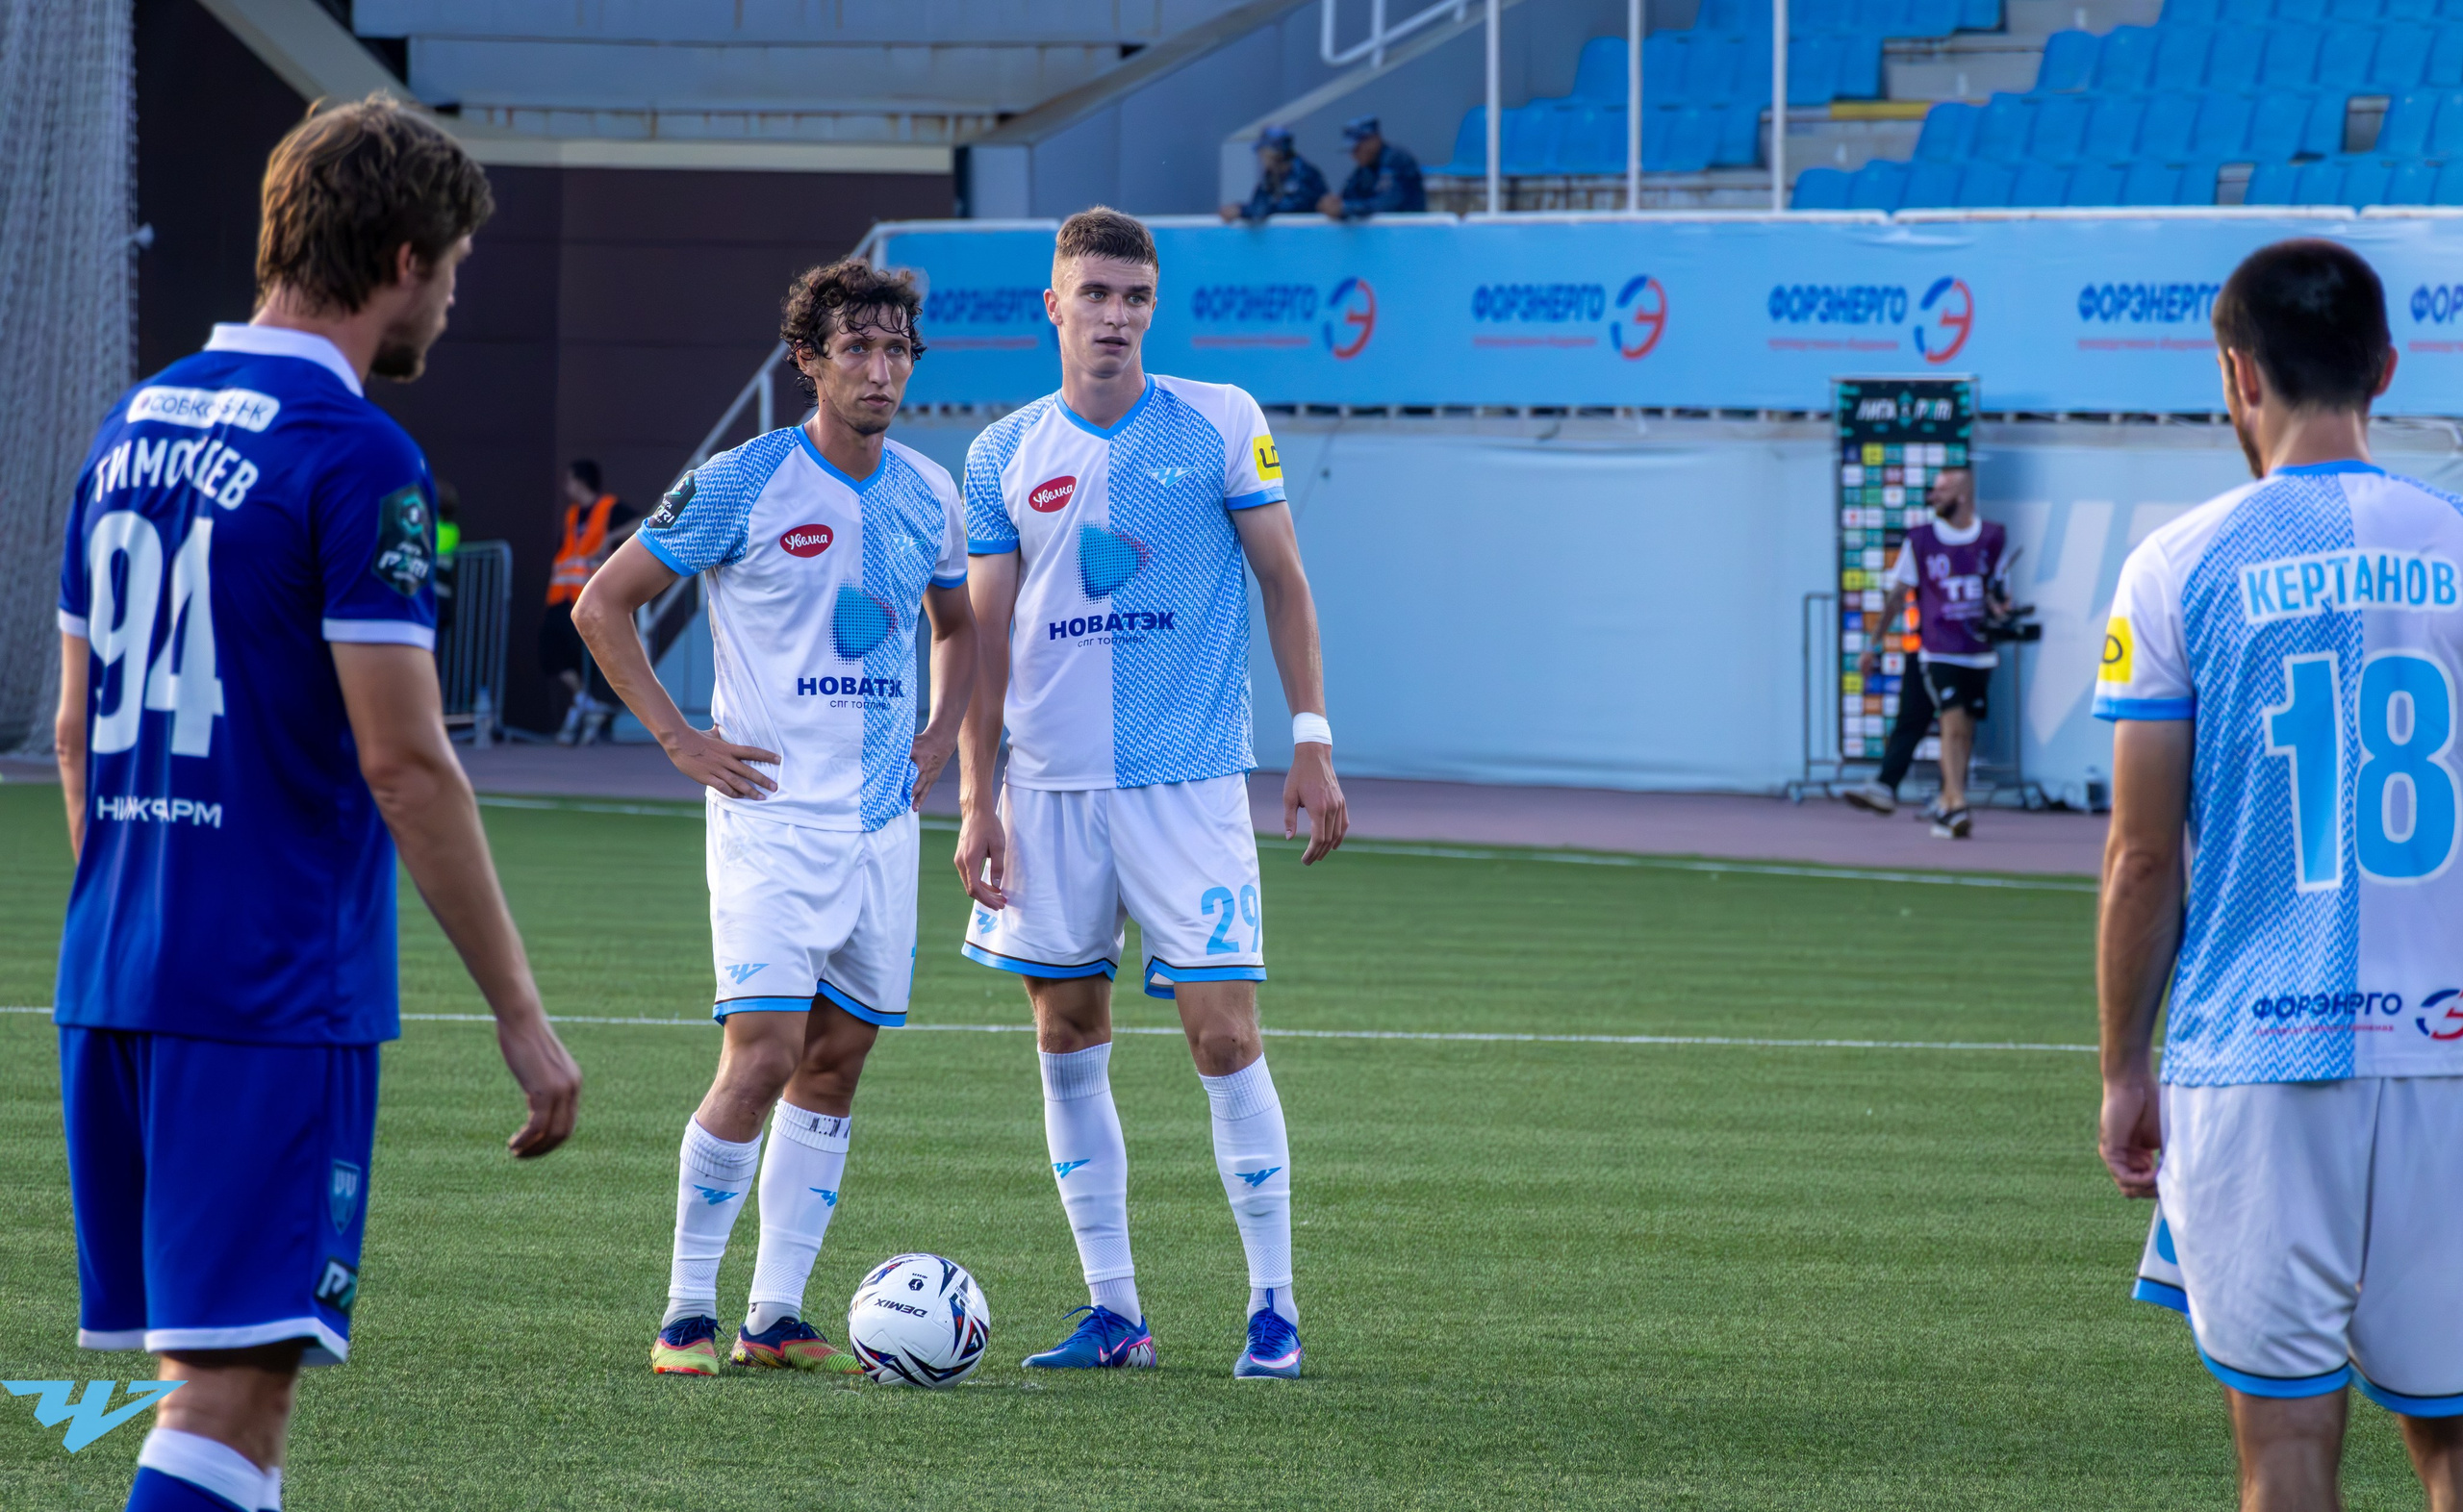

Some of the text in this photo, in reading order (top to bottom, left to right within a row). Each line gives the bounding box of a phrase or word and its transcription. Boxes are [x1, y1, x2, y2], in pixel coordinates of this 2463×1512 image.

[1768, 285, 1907, 322] ФОРЭНЕРГО
[1032, 484, 1073, 508] Увелка
[784, 533, 828, 550] Увелка
[2246, 554, 2457, 617] КЕРТАНОВ
[89, 510, 225, 758] 94
[1049, 612, 1175, 640] НОВАТЭК
[1078, 636, 1147, 647] СПГ ТОПЛИВО
[798, 676, 905, 698] НОВАТЭК
[851, 700, 891, 711] ТОПЛИВО
[2267, 652, 2457, 890] 18
[1201, 884, 1260, 956] 29
[874, 1298, 928, 1319] DEMIX
